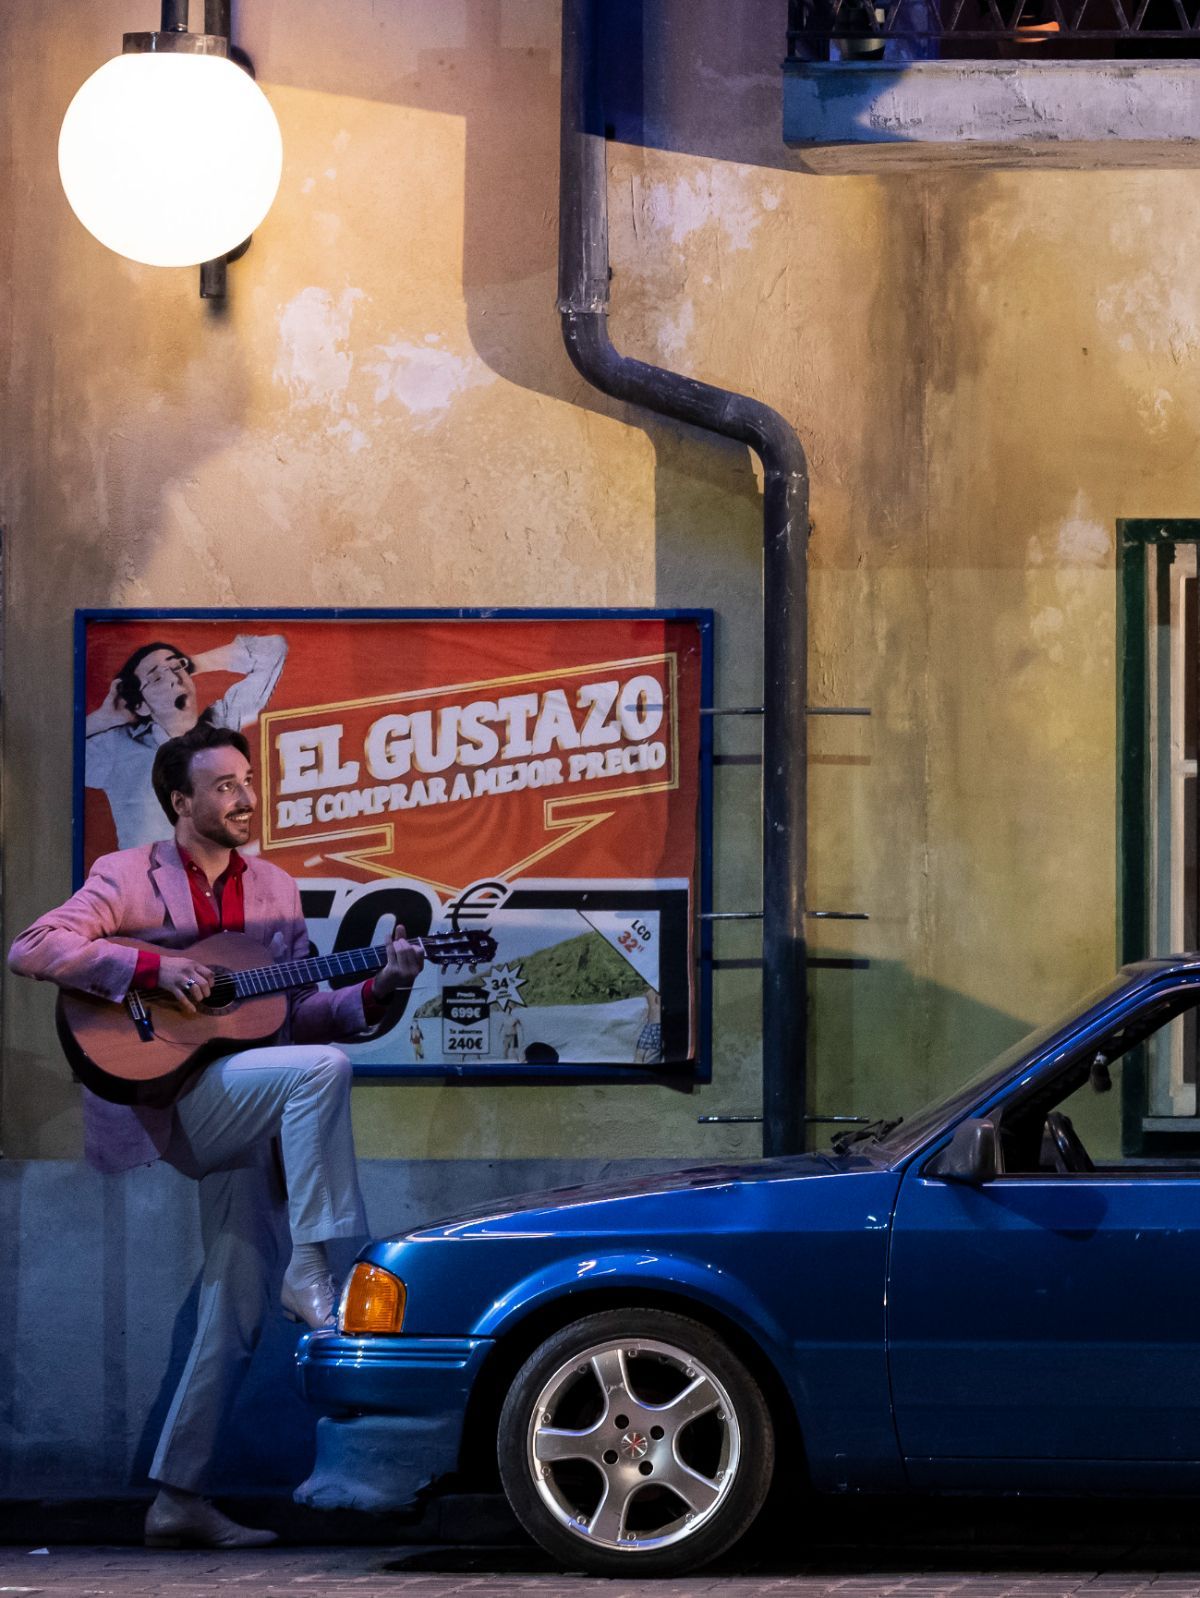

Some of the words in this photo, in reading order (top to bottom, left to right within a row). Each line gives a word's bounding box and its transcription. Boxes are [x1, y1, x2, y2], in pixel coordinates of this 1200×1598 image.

[276, 724, 360, 795] EL
[364, 675, 664, 780] GUSTAZO
[276, 798, 313, 829] DE
[316, 777, 448, 822] COMPRAR
[450, 773, 472, 801] A
[473, 758, 564, 797] MEJOR
[568, 741, 666, 782] PRECIO
[631, 920, 651, 941] LCD
[451, 1007, 481, 1018] 699€
[448, 1037, 483, 1050] 240€
